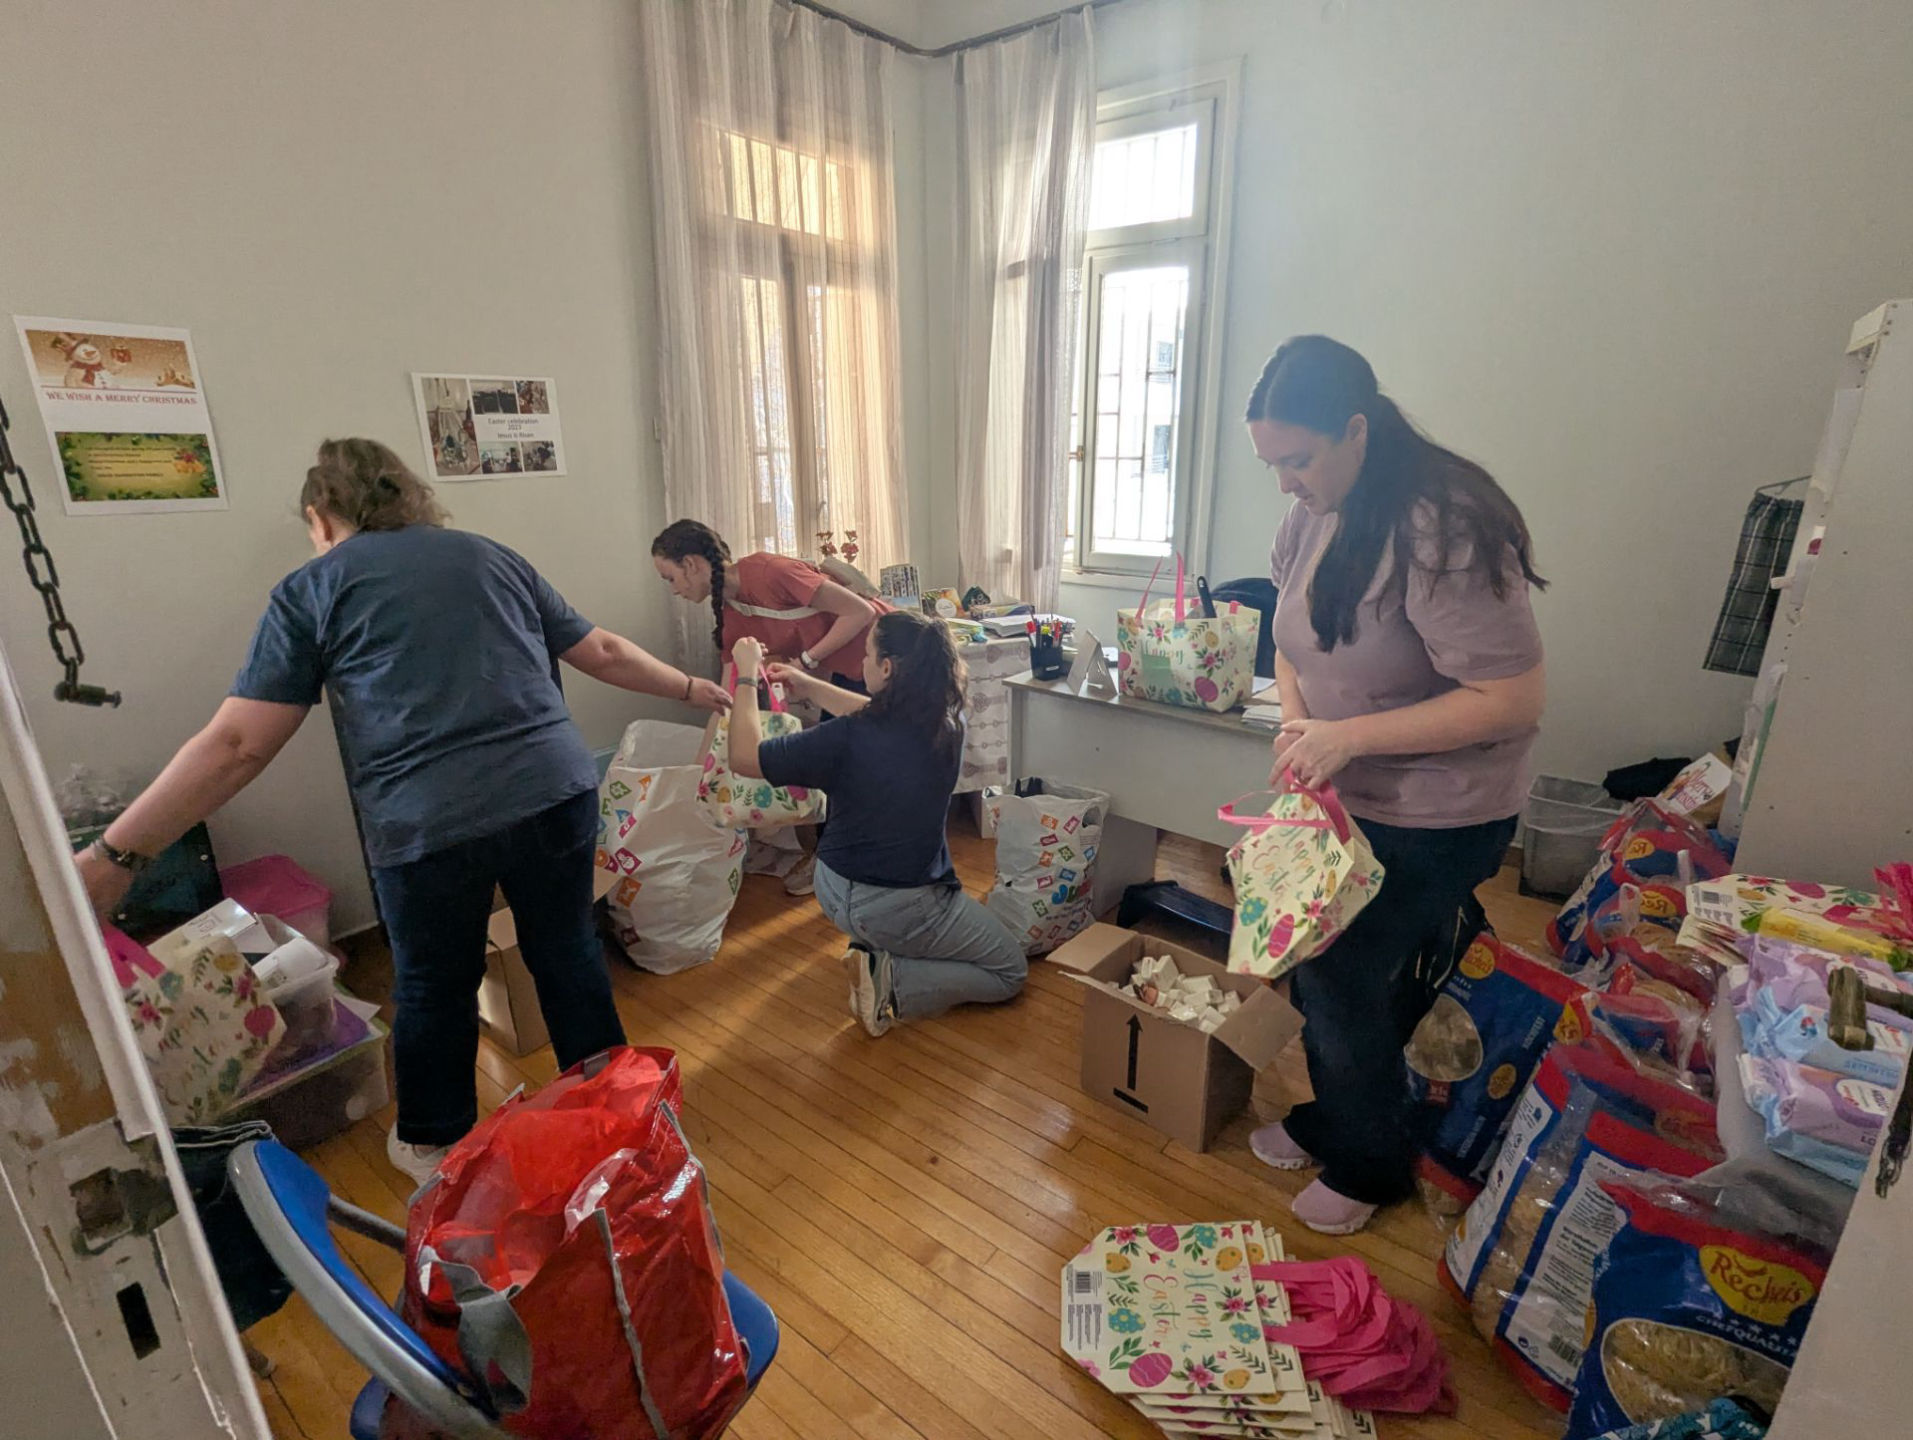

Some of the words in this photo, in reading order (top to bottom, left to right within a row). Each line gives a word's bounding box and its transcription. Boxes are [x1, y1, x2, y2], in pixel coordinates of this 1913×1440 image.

[46, 391, 64, 400] WE
[66, 391, 93, 401] WISH
[95, 393, 104, 402] A
[105, 393, 141, 404] MERRY
[142, 395, 198, 405] CHRISTMAS
[1143, 1274, 1181, 1338] Easter
[1182, 1267, 1222, 1341] Happy
[1710, 1251, 1802, 1304] Recheis
